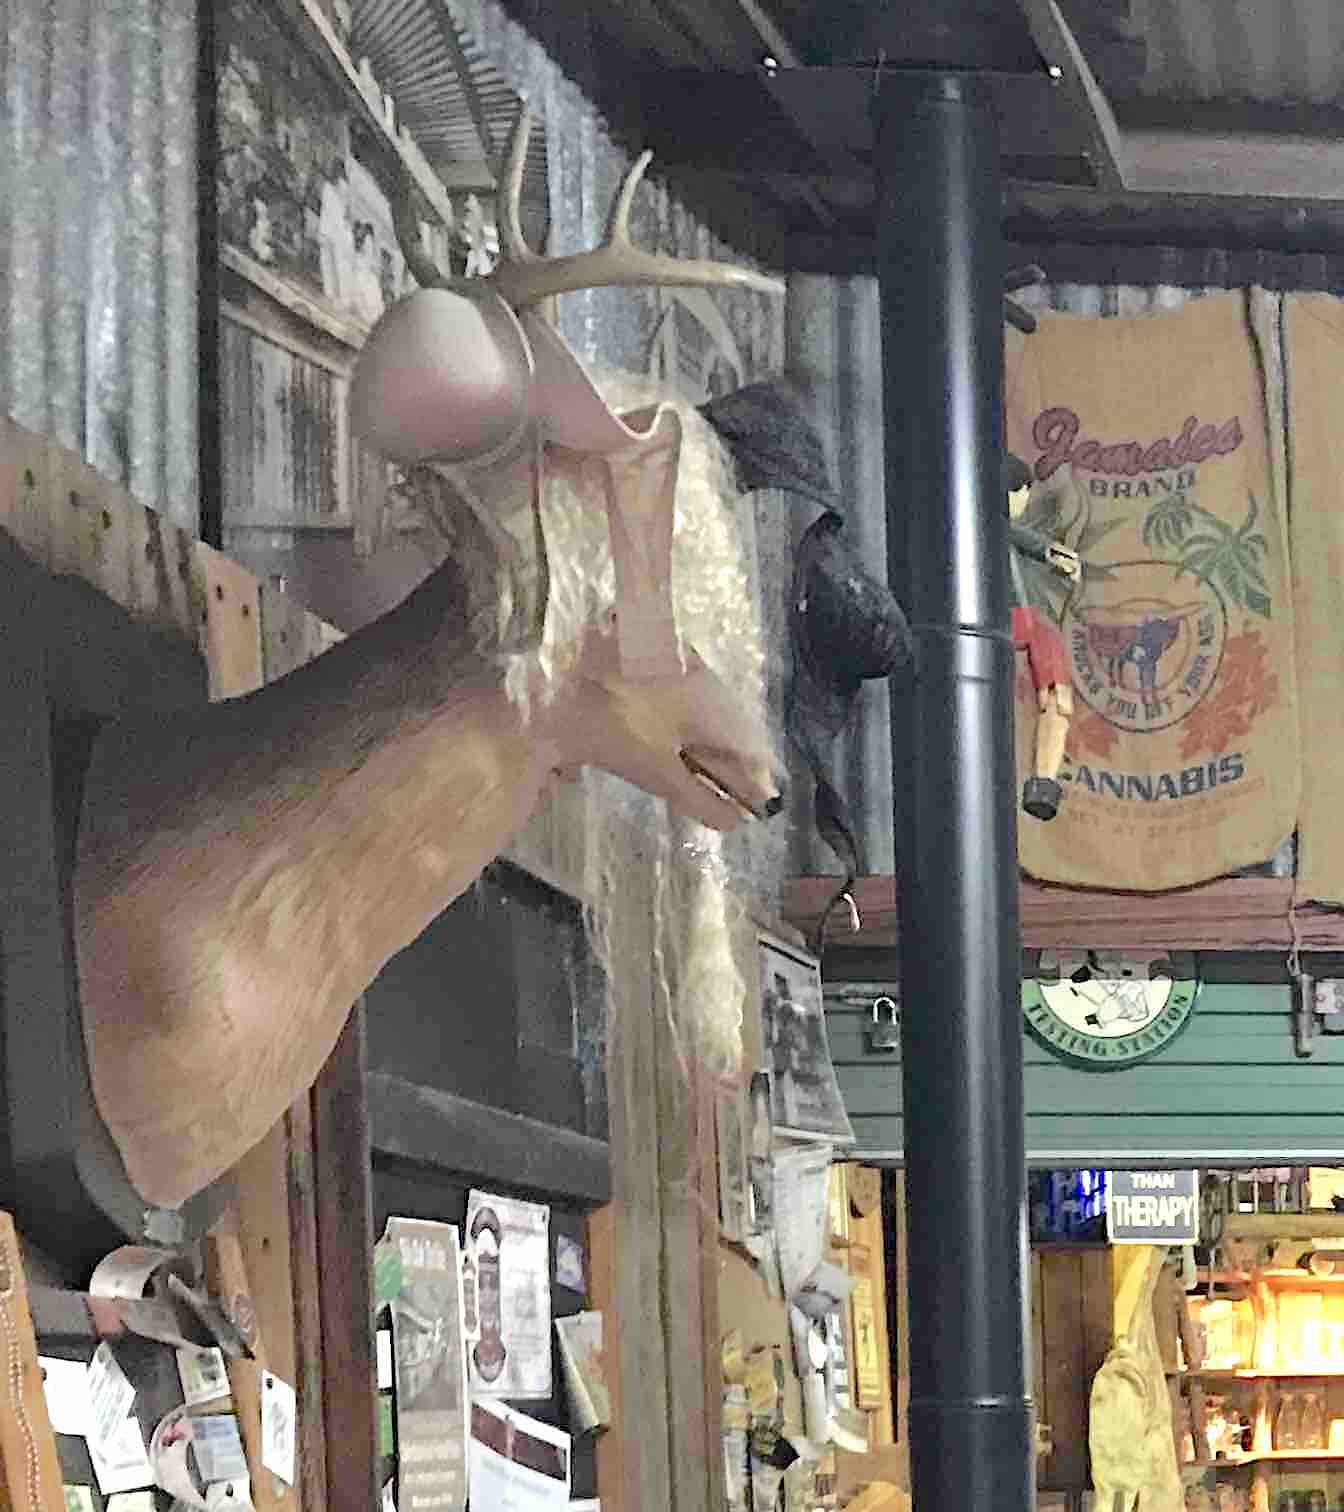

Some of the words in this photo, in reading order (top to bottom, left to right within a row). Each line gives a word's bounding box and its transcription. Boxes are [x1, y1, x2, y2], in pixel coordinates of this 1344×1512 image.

[1090, 470, 1196, 498] BRAND
[1057, 752, 1245, 800] ANNABIS
[1118, 994, 1189, 1055] STATION
[1130, 1172, 1176, 1189] THAN
[1111, 1195, 1195, 1228] THERAPY
